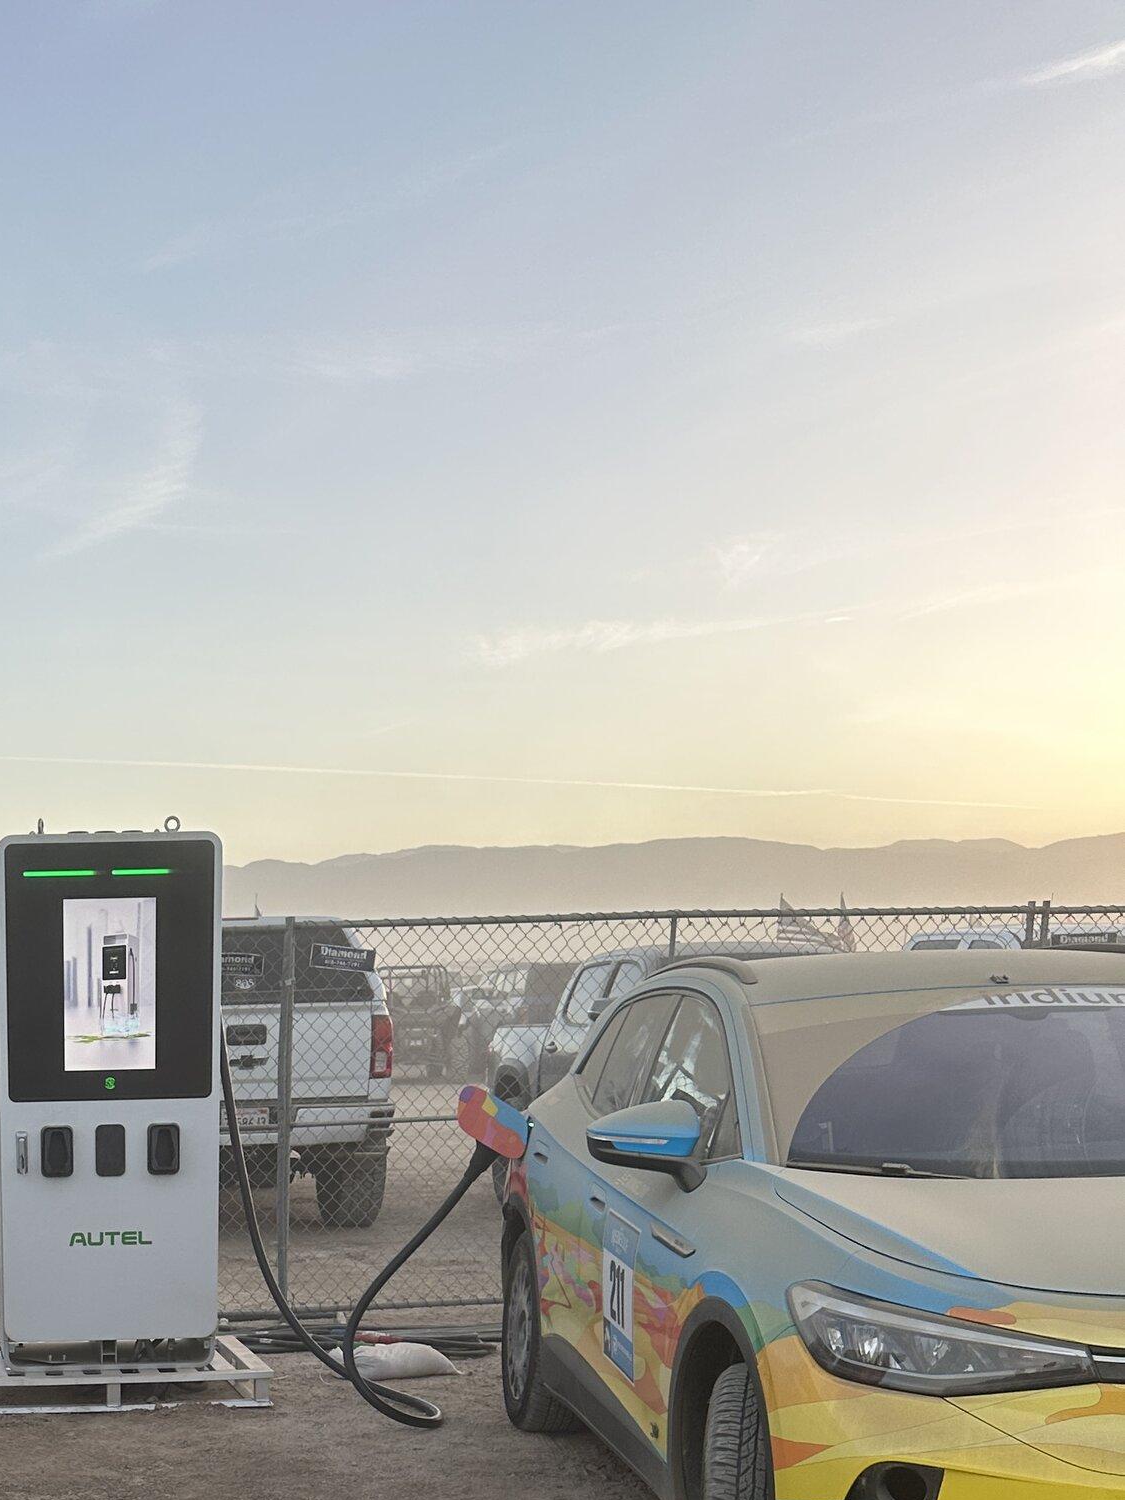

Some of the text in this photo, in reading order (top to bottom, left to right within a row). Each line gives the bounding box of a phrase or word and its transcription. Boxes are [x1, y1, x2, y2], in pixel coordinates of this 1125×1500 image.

[320, 946, 367, 960] Diamond
[69, 1231, 152, 1247] AUTEL
[610, 1260, 625, 1330] 211
